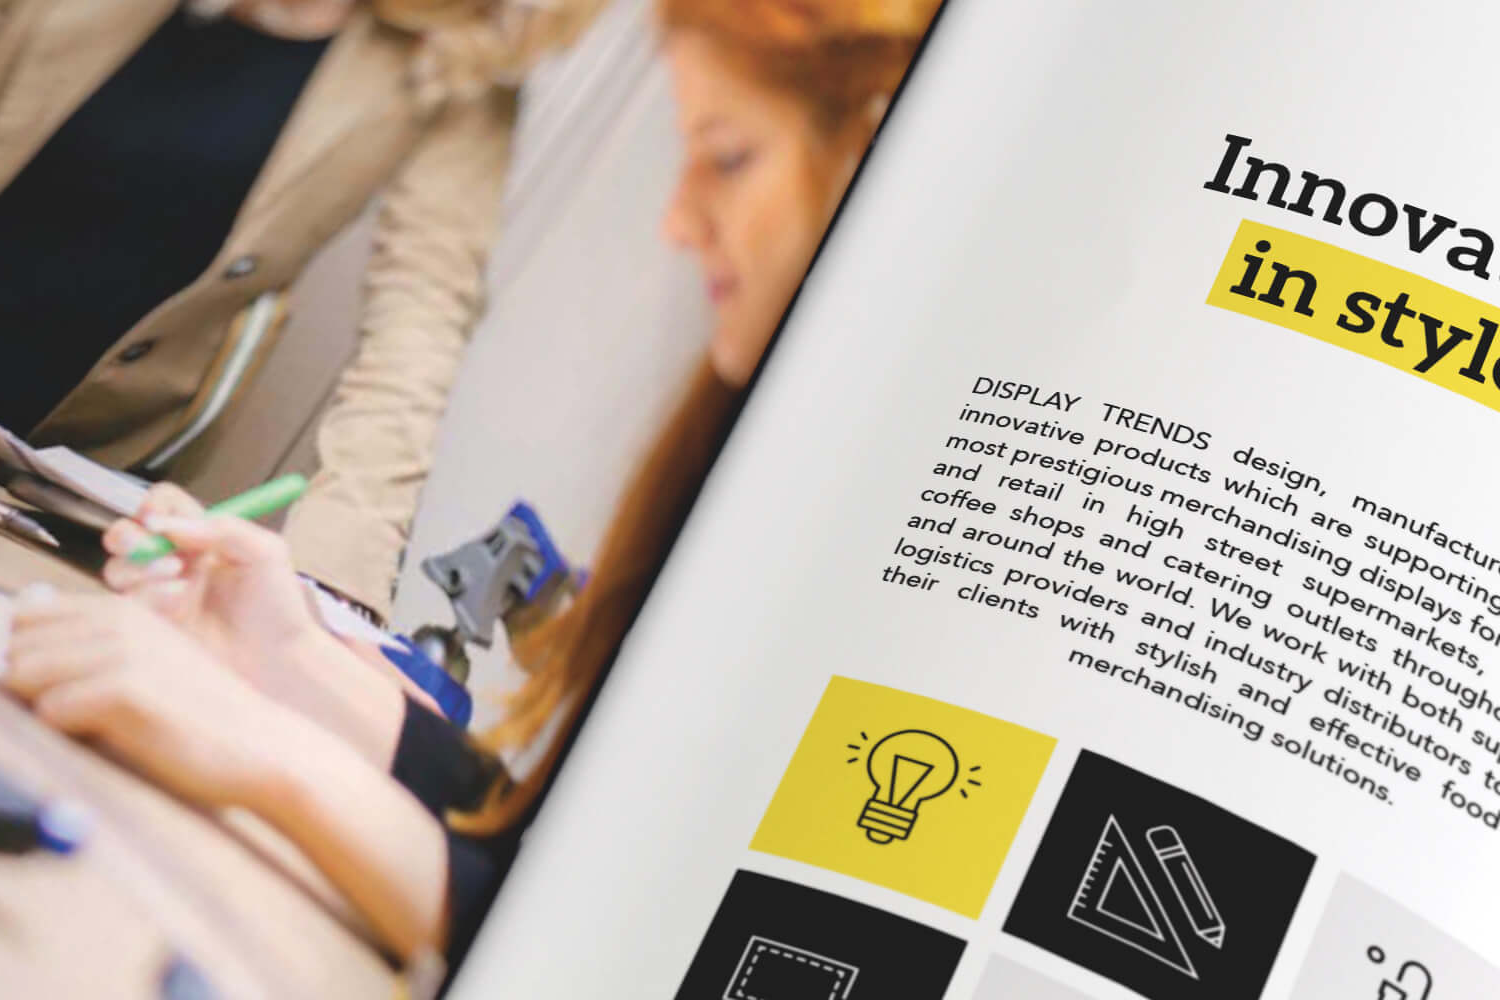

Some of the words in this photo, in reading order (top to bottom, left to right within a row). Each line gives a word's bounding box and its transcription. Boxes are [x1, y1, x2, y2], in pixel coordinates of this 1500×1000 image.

[1203, 134, 1500, 281] Innova
[1229, 239, 1317, 318] in
[1336, 291, 1500, 391] styl
[945, 435, 1009, 459] most
[1008, 448, 1154, 497] prestigious
[1159, 489, 1353, 577] merchandising
[1359, 565, 1463, 625] displays
[958, 403, 1085, 446] innovative
[1092, 438, 1212, 484] products
[1224, 476, 1299, 517] which
[1310, 511, 1353, 538] are
[971, 376, 1083, 413] DISPLAY
[1103, 402, 1213, 451] TRENDS
[1232, 446, 1327, 497] design,
[1351, 495, 1500, 575] manufactur
[893, 536, 995, 576] logistics
[1002, 568, 1129, 616] providers
[1140, 611, 1196, 641] and
[1204, 630, 1313, 695] industry
[1323, 686, 1471, 776] distributors
[907, 515, 958, 536] and
[961, 527, 1056, 560] around
[1063, 549, 1105, 575] the
[1116, 568, 1195, 609] world.
[1211, 597, 1252, 630] We
[1263, 623, 1328, 665] work
[1338, 658, 1392, 696] with
[1401, 684, 1463, 733] both
[1471, 730, 1500, 764] su
[920, 488, 997, 515] coffee
[1009, 504, 1085, 539] shops
[1098, 533, 1153, 559] and
[1163, 555, 1273, 610] catering
[1286, 603, 1378, 653] outlets
[932, 462, 983, 482] and
[997, 475, 1065, 502] retail
[1081, 491, 1105, 514] in
[1125, 503, 1184, 540] high
[1203, 537, 1284, 577] street
[1302, 576, 1484, 676] supermarkets,
[881, 565, 941, 591] their
[957, 583, 1040, 619] clients
[1060, 614, 1115, 644] with
[1134, 641, 1218, 684] stylish
[1237, 683, 1292, 716] and
[1309, 716, 1421, 782] effective
[1068, 649, 1265, 742] merchandising
[1270, 732, 1393, 805] solutions.
